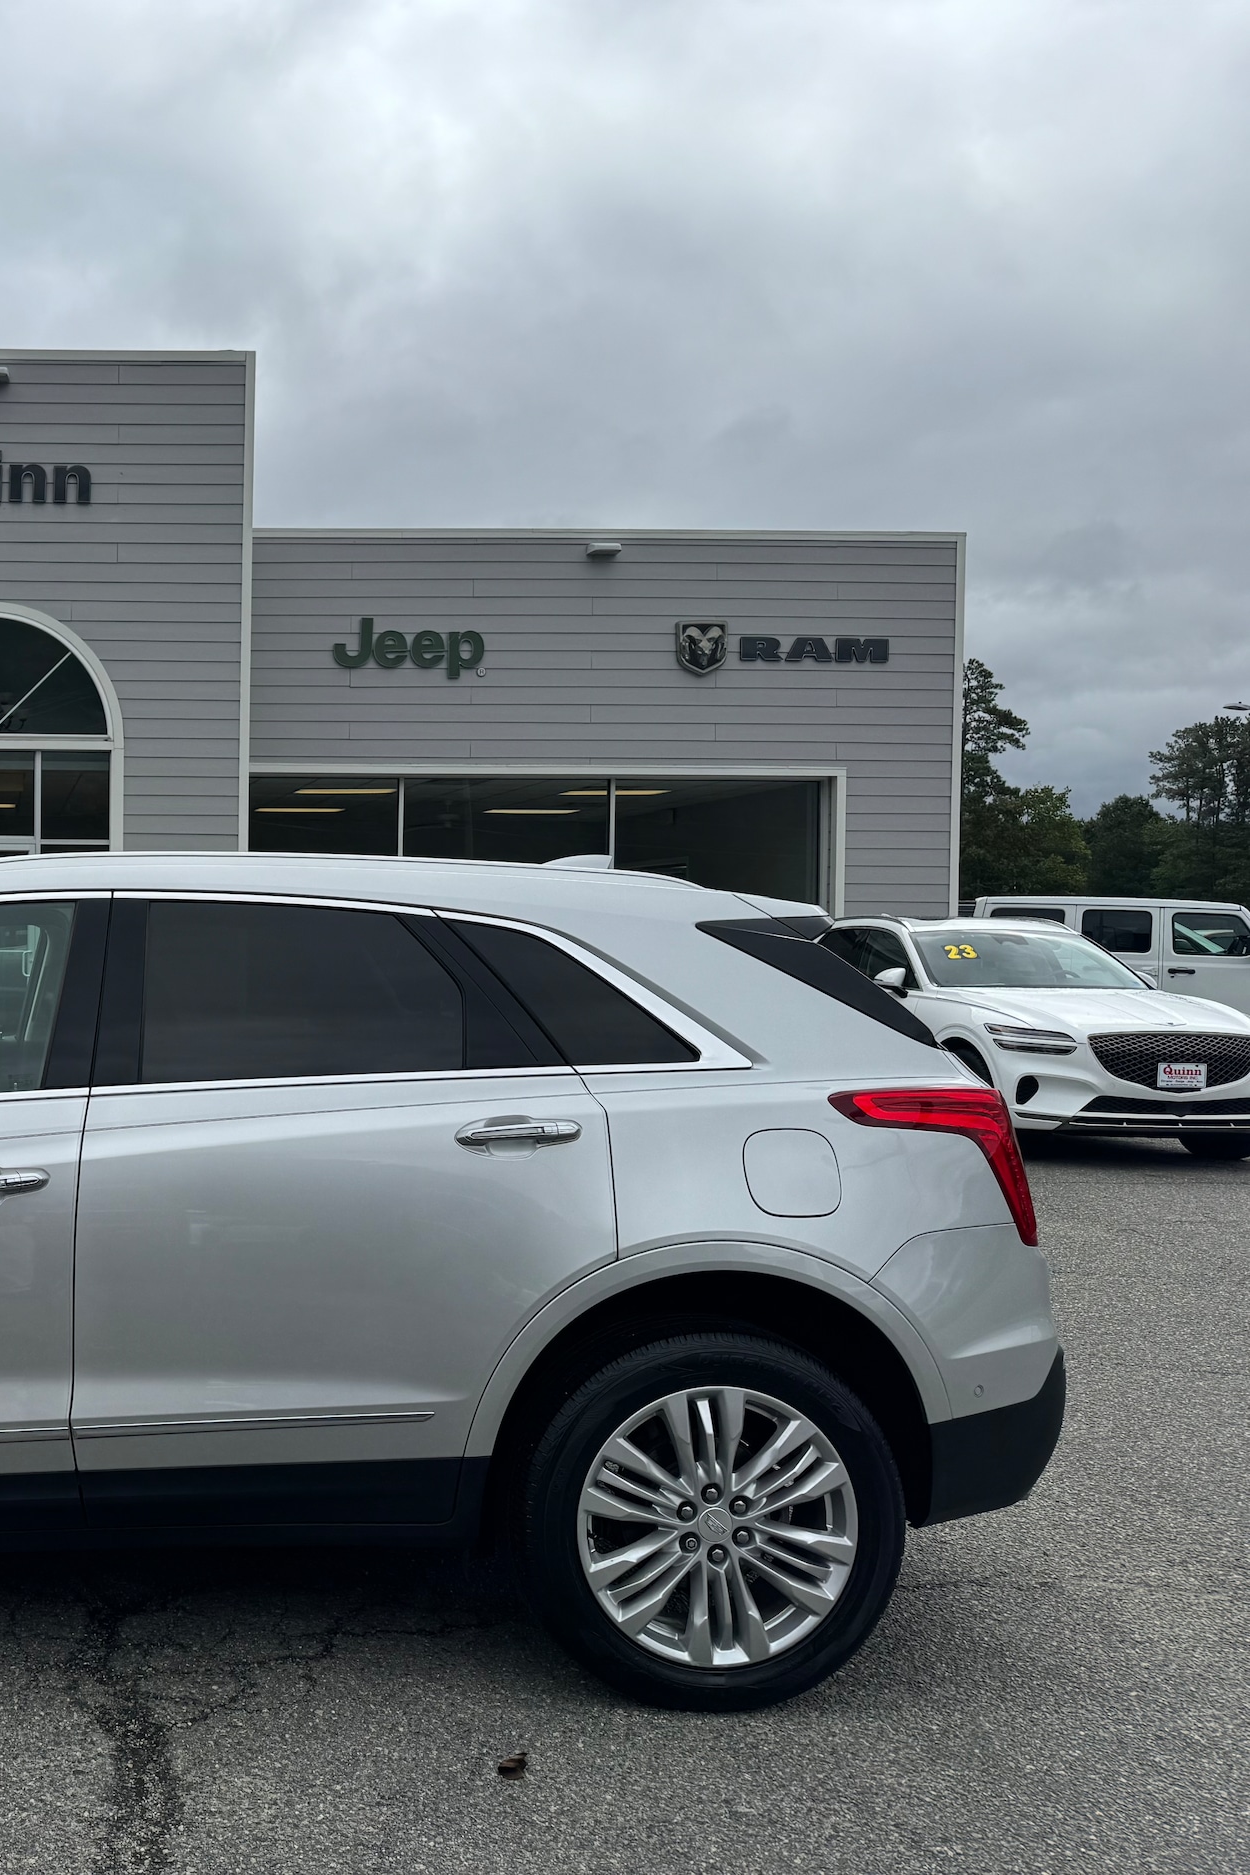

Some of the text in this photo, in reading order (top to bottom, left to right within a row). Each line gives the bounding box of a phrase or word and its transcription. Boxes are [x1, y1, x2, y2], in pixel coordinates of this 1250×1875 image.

[333, 617, 485, 679] Jeep
[740, 636, 889, 663] RAM
[944, 944, 978, 959] 23
[1163, 1065, 1202, 1076] Quinn
